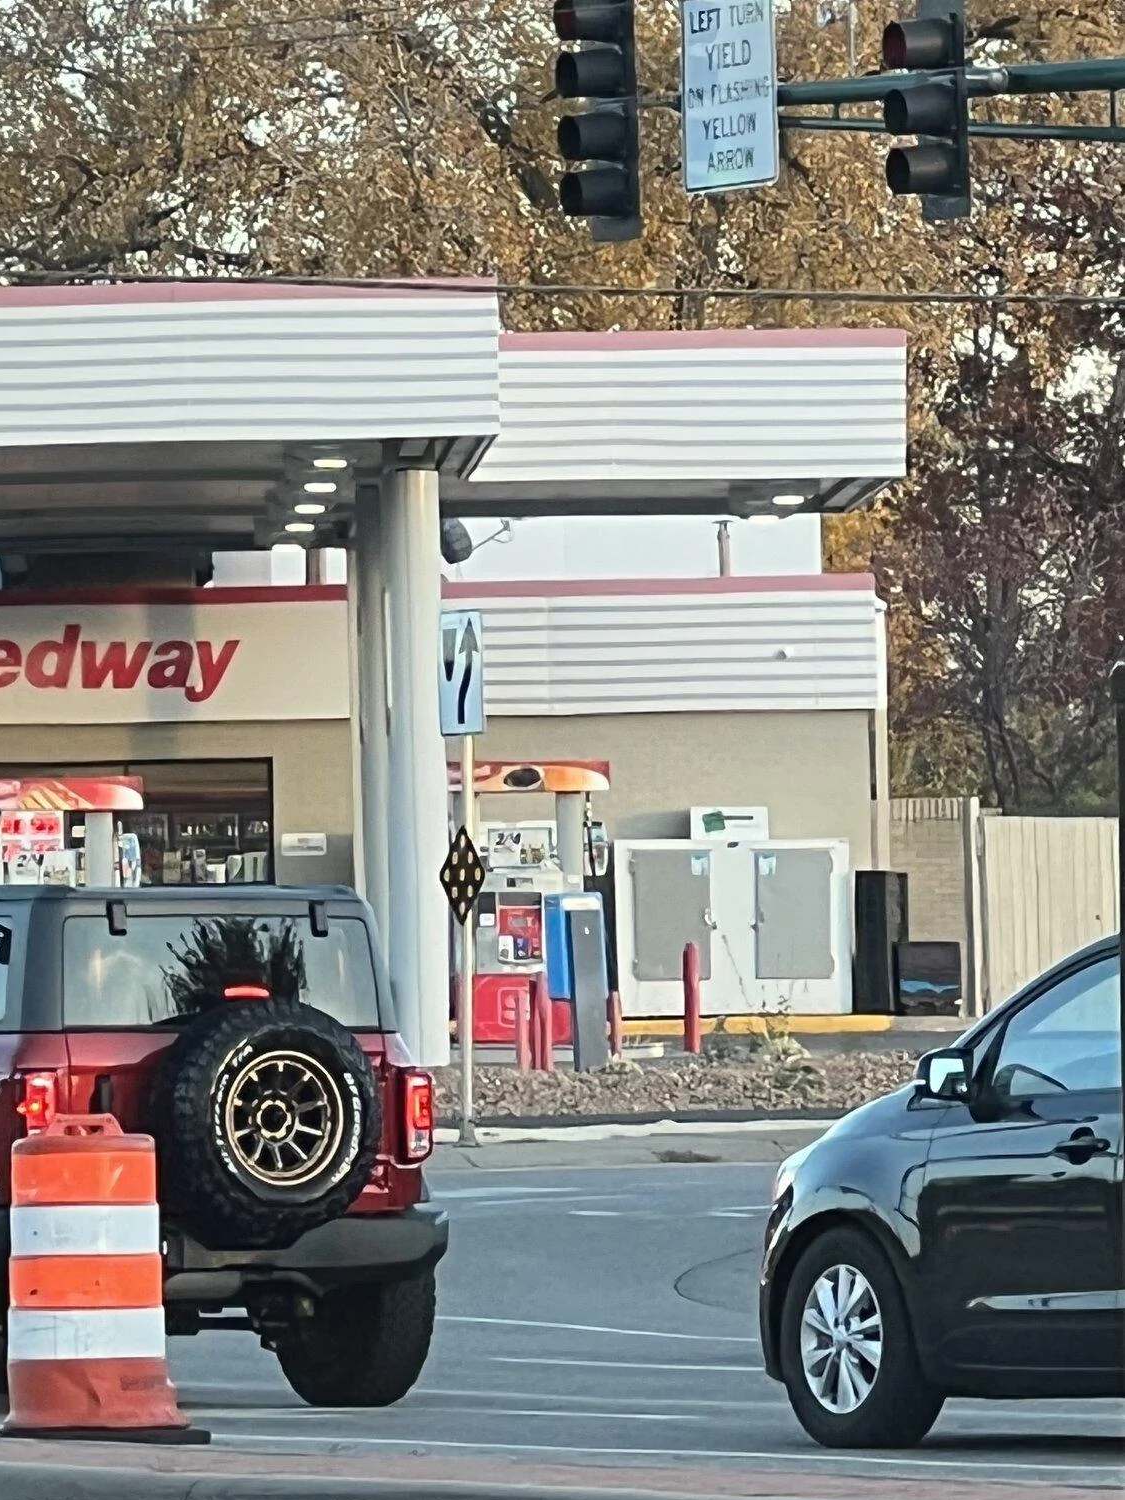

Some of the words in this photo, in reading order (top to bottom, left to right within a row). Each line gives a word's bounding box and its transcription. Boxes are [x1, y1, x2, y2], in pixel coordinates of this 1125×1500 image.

[689, 8, 721, 34] LEFT
[729, 2, 764, 27] TURN
[705, 39, 752, 71] YIELD
[687, 87, 704, 109] ON
[702, 112, 757, 140] YELLOW
[707, 146, 755, 174] ARROW
